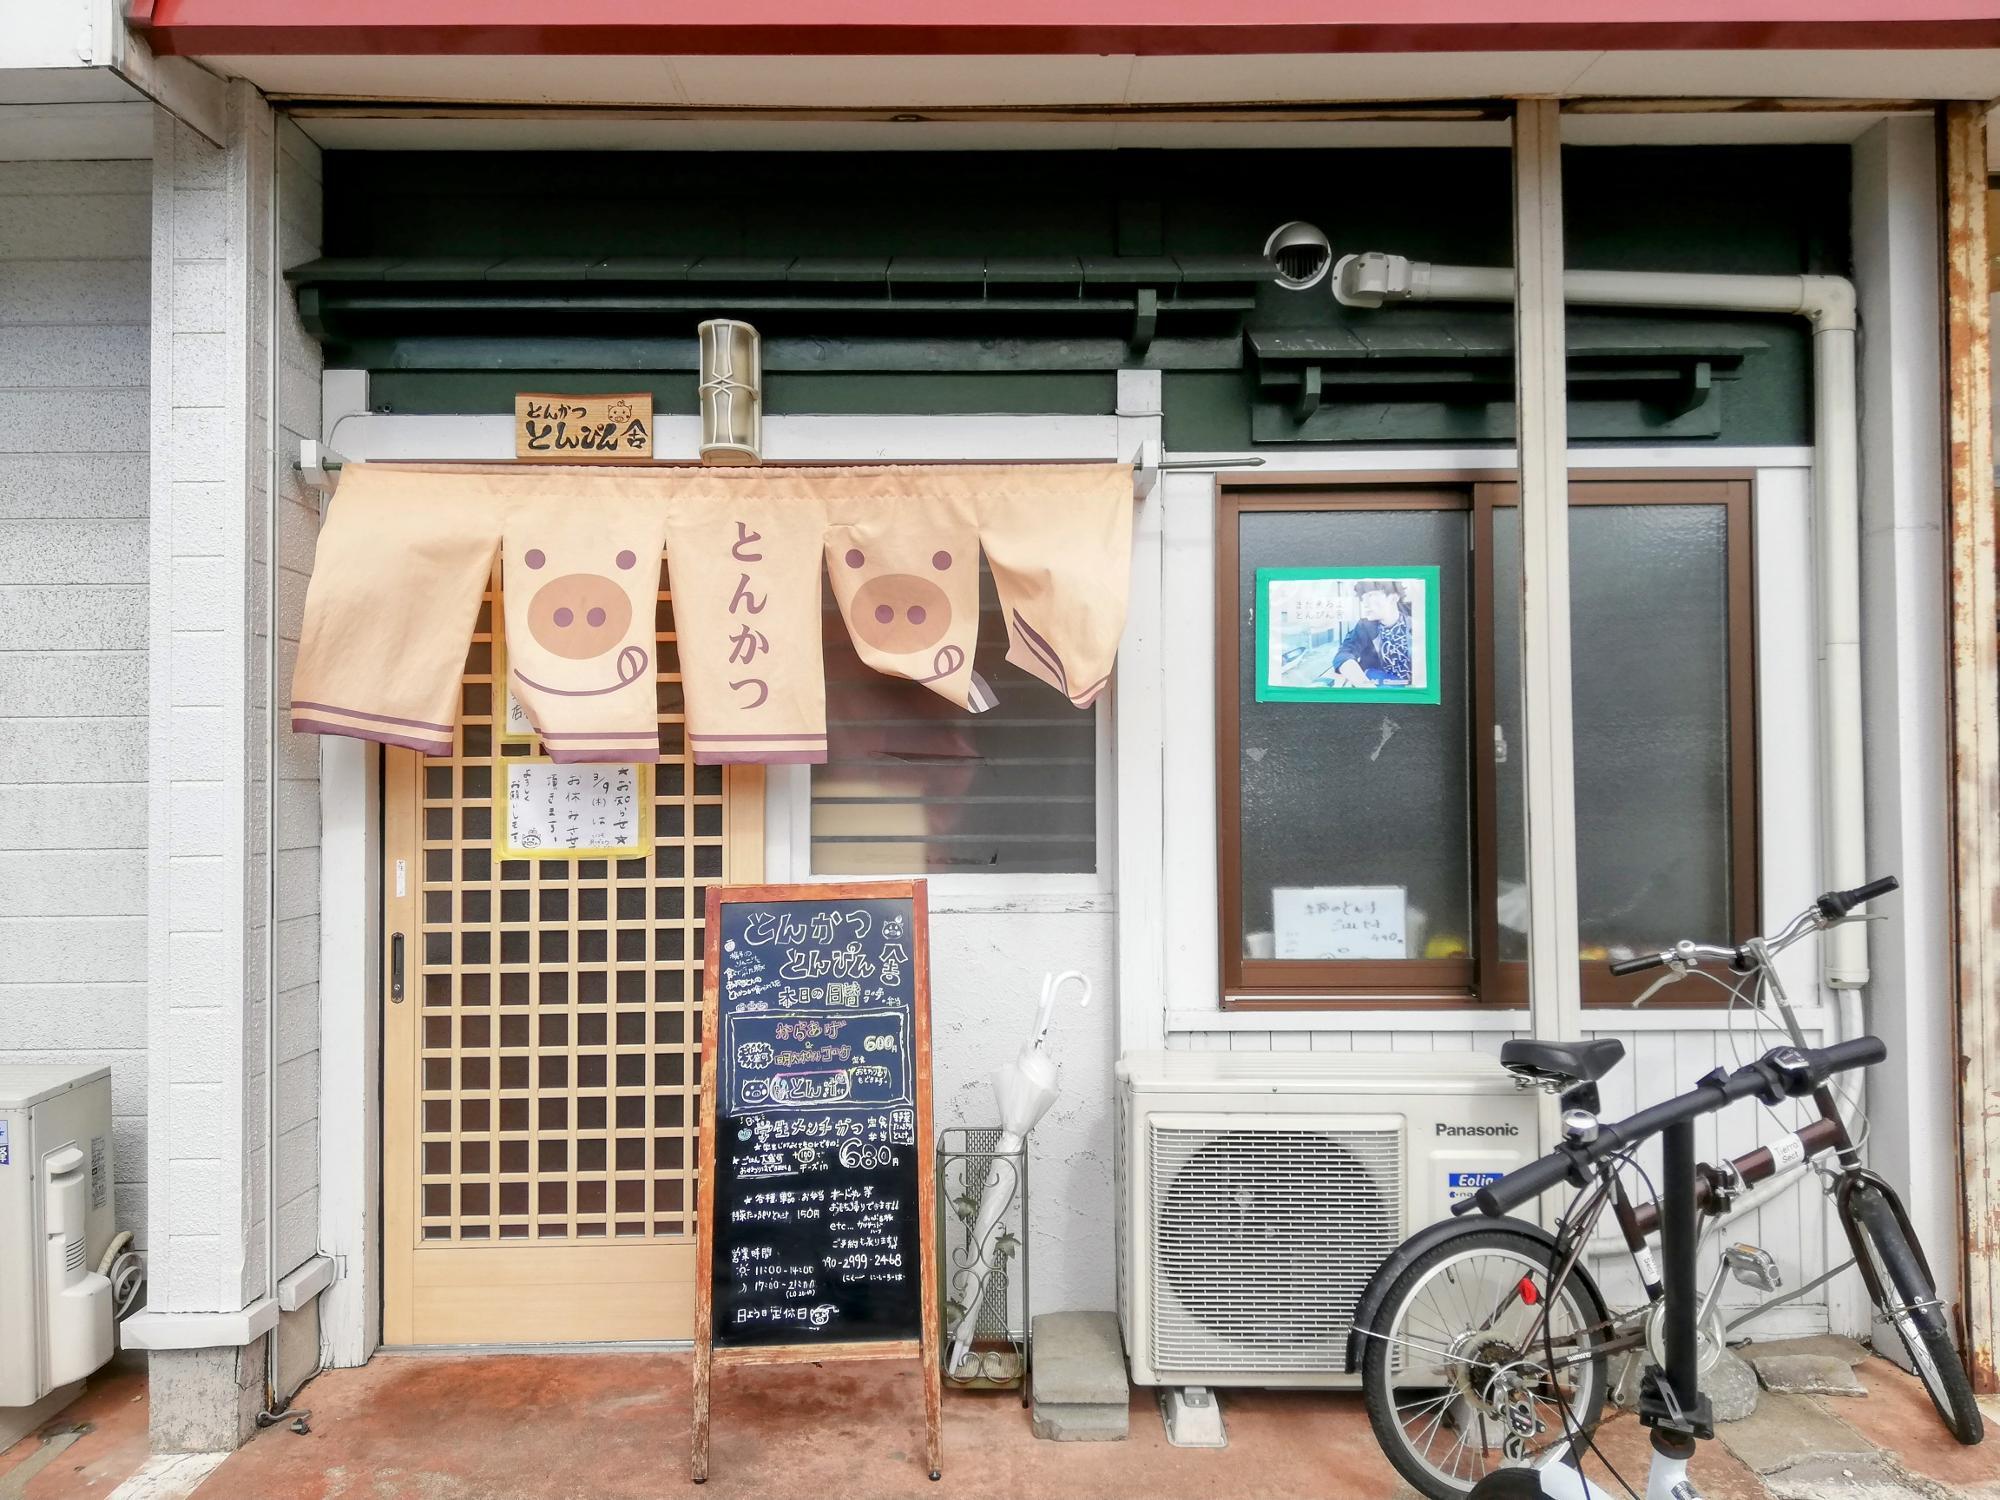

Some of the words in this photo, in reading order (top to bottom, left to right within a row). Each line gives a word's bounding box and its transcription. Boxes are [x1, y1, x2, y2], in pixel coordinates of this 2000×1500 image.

[526, 401, 587, 420] とんかつ
[526, 418, 648, 451] とんぴん舎
[728, 521, 769, 710] とんかつ
[613, 781, 632, 830] お知らせ
[744, 910, 872, 946] とんかつ
[775, 1020, 847, 1041] からあげ
[1435, 1123, 1519, 1136] Panasonic
[797, 1207, 821, 1220] 150円
[731, 1246, 773, 1264] 営業時間
